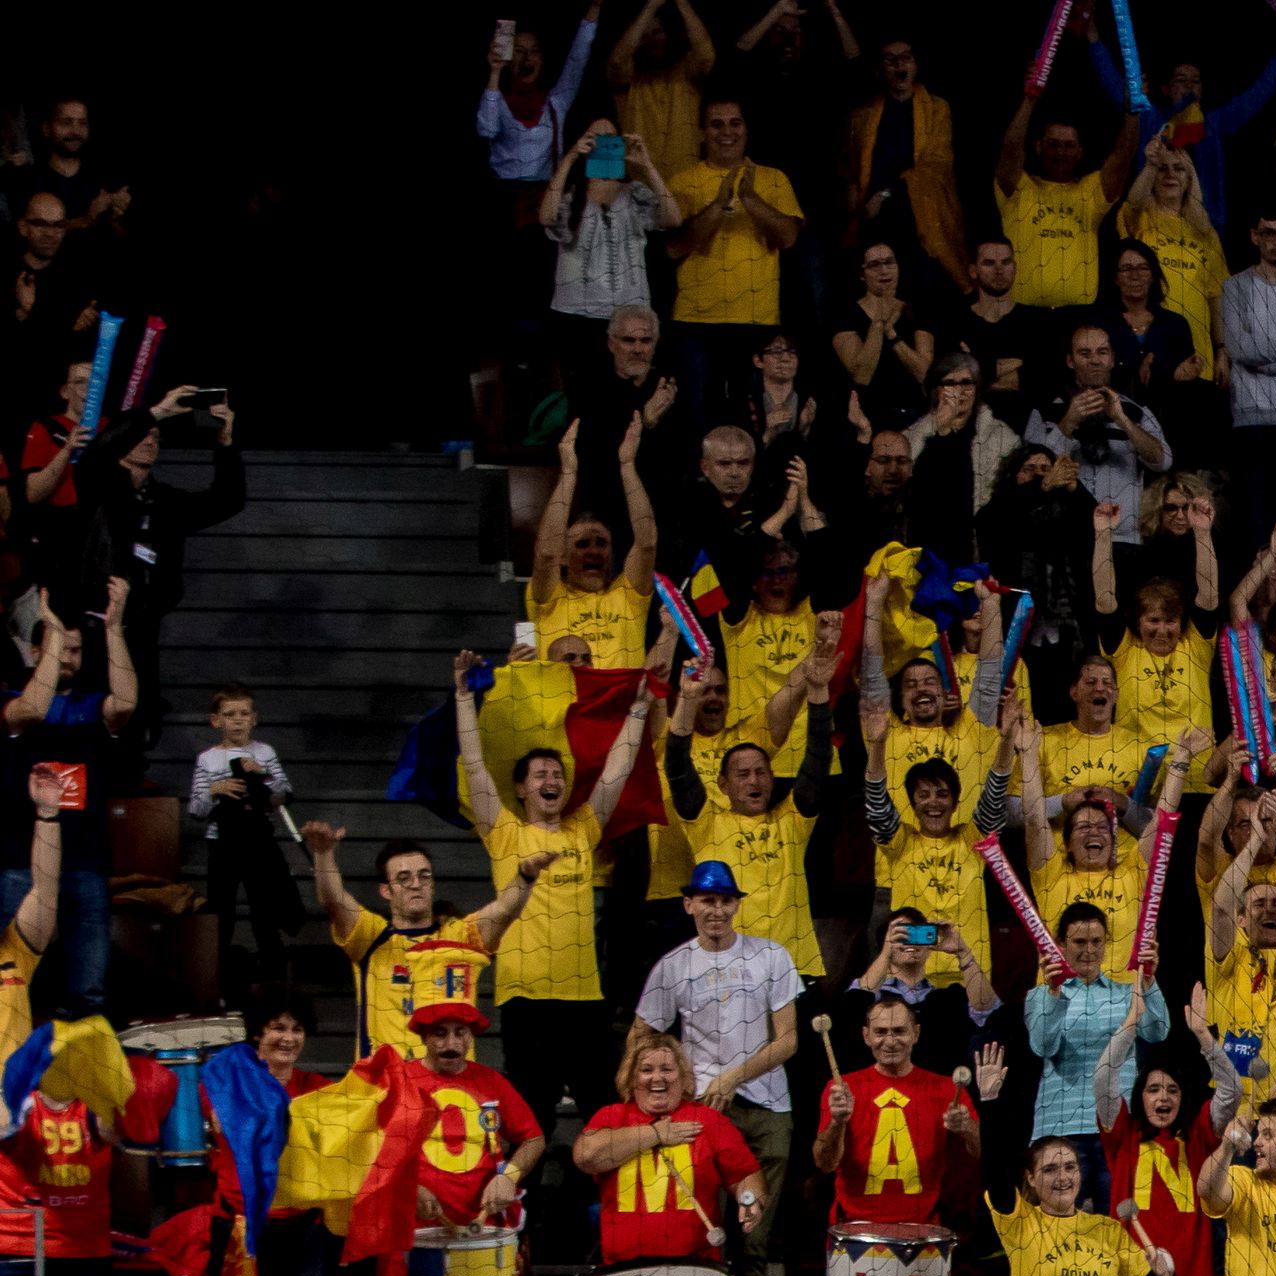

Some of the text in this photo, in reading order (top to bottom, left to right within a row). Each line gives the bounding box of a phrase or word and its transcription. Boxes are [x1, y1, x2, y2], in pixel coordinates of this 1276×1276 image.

[421, 1088, 485, 1174] O
[864, 1086, 924, 1193] Â
[616, 1142, 696, 1213] M
[1133, 1141, 1195, 1213] N
